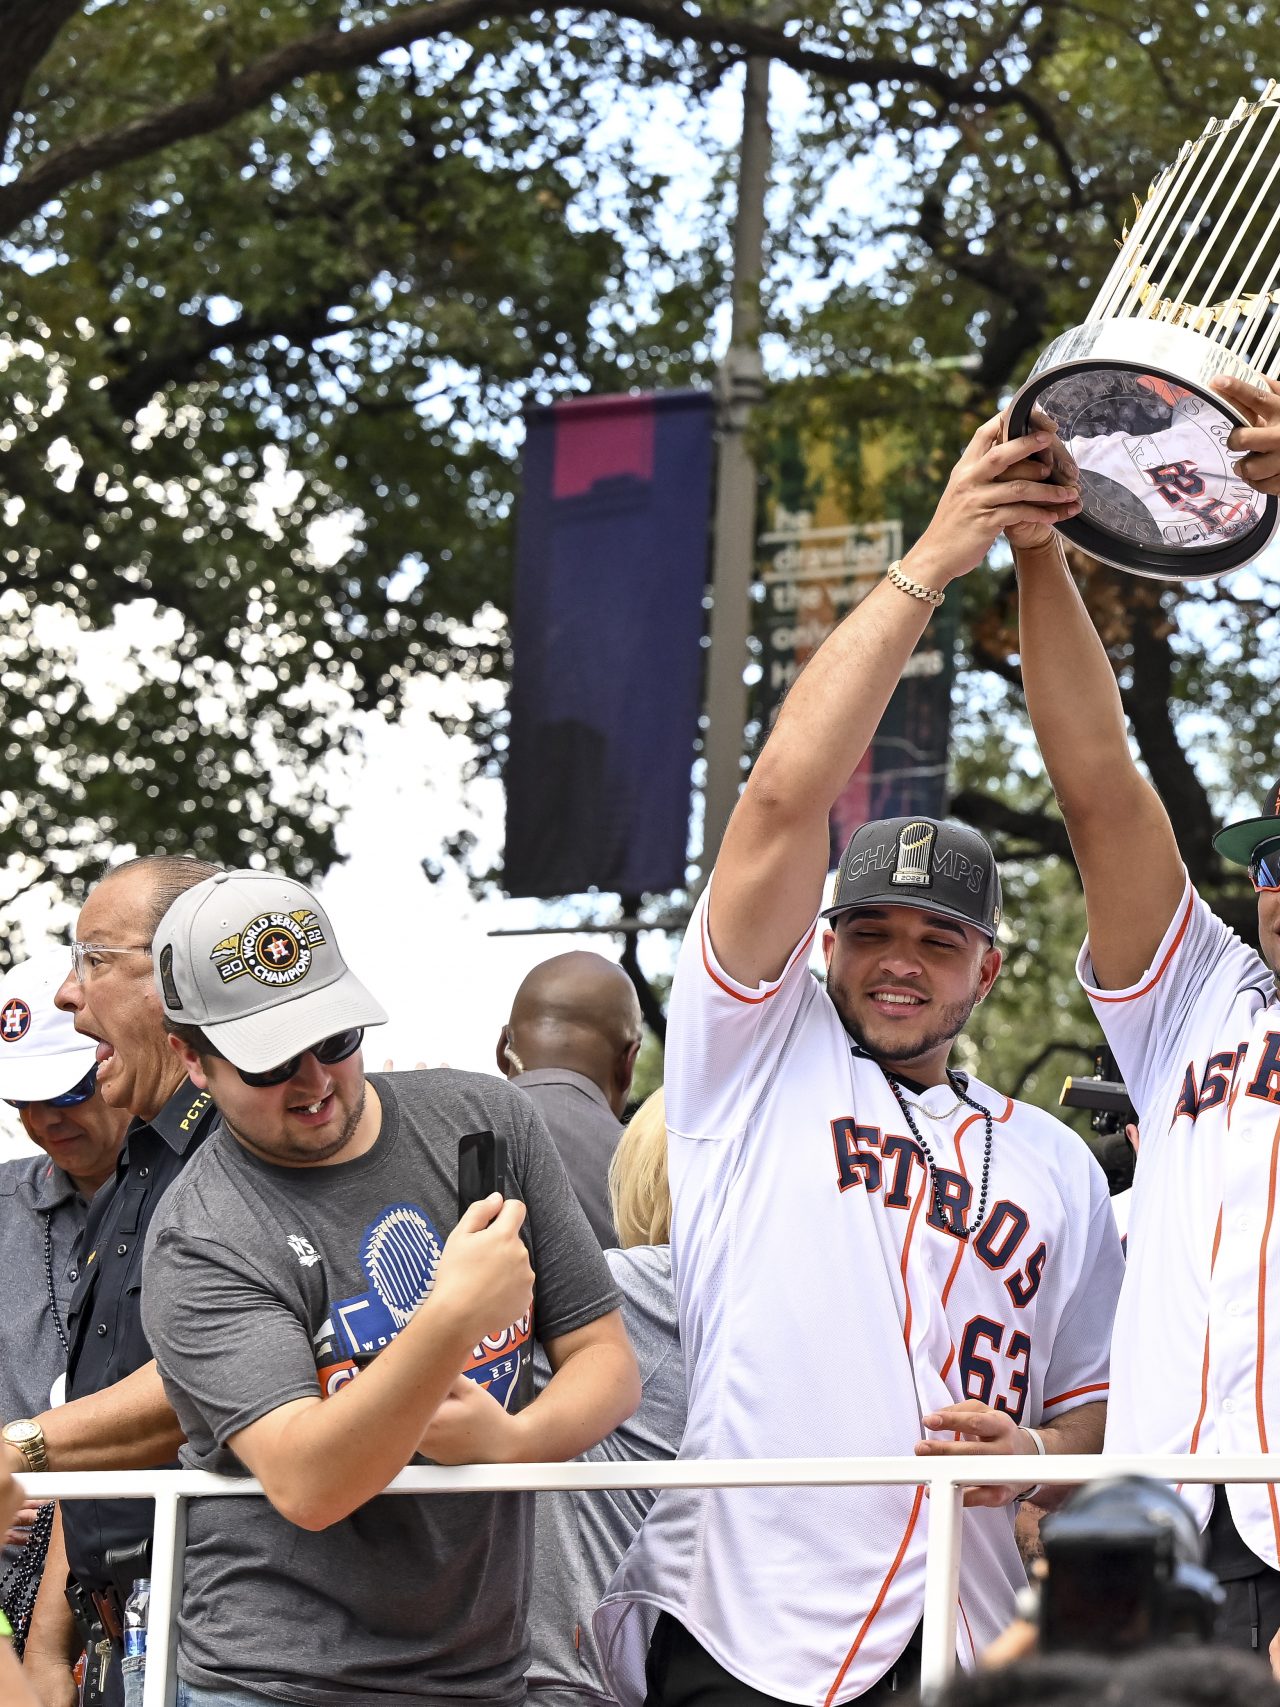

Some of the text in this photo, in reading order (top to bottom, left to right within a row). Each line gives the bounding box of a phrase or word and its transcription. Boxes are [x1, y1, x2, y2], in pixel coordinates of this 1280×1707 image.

[243, 914, 306, 959] WORLD SERIES
[220, 959, 244, 977] 20
[253, 949, 311, 984] CHAMPIONS
[957, 1314, 1032, 1428] 63
